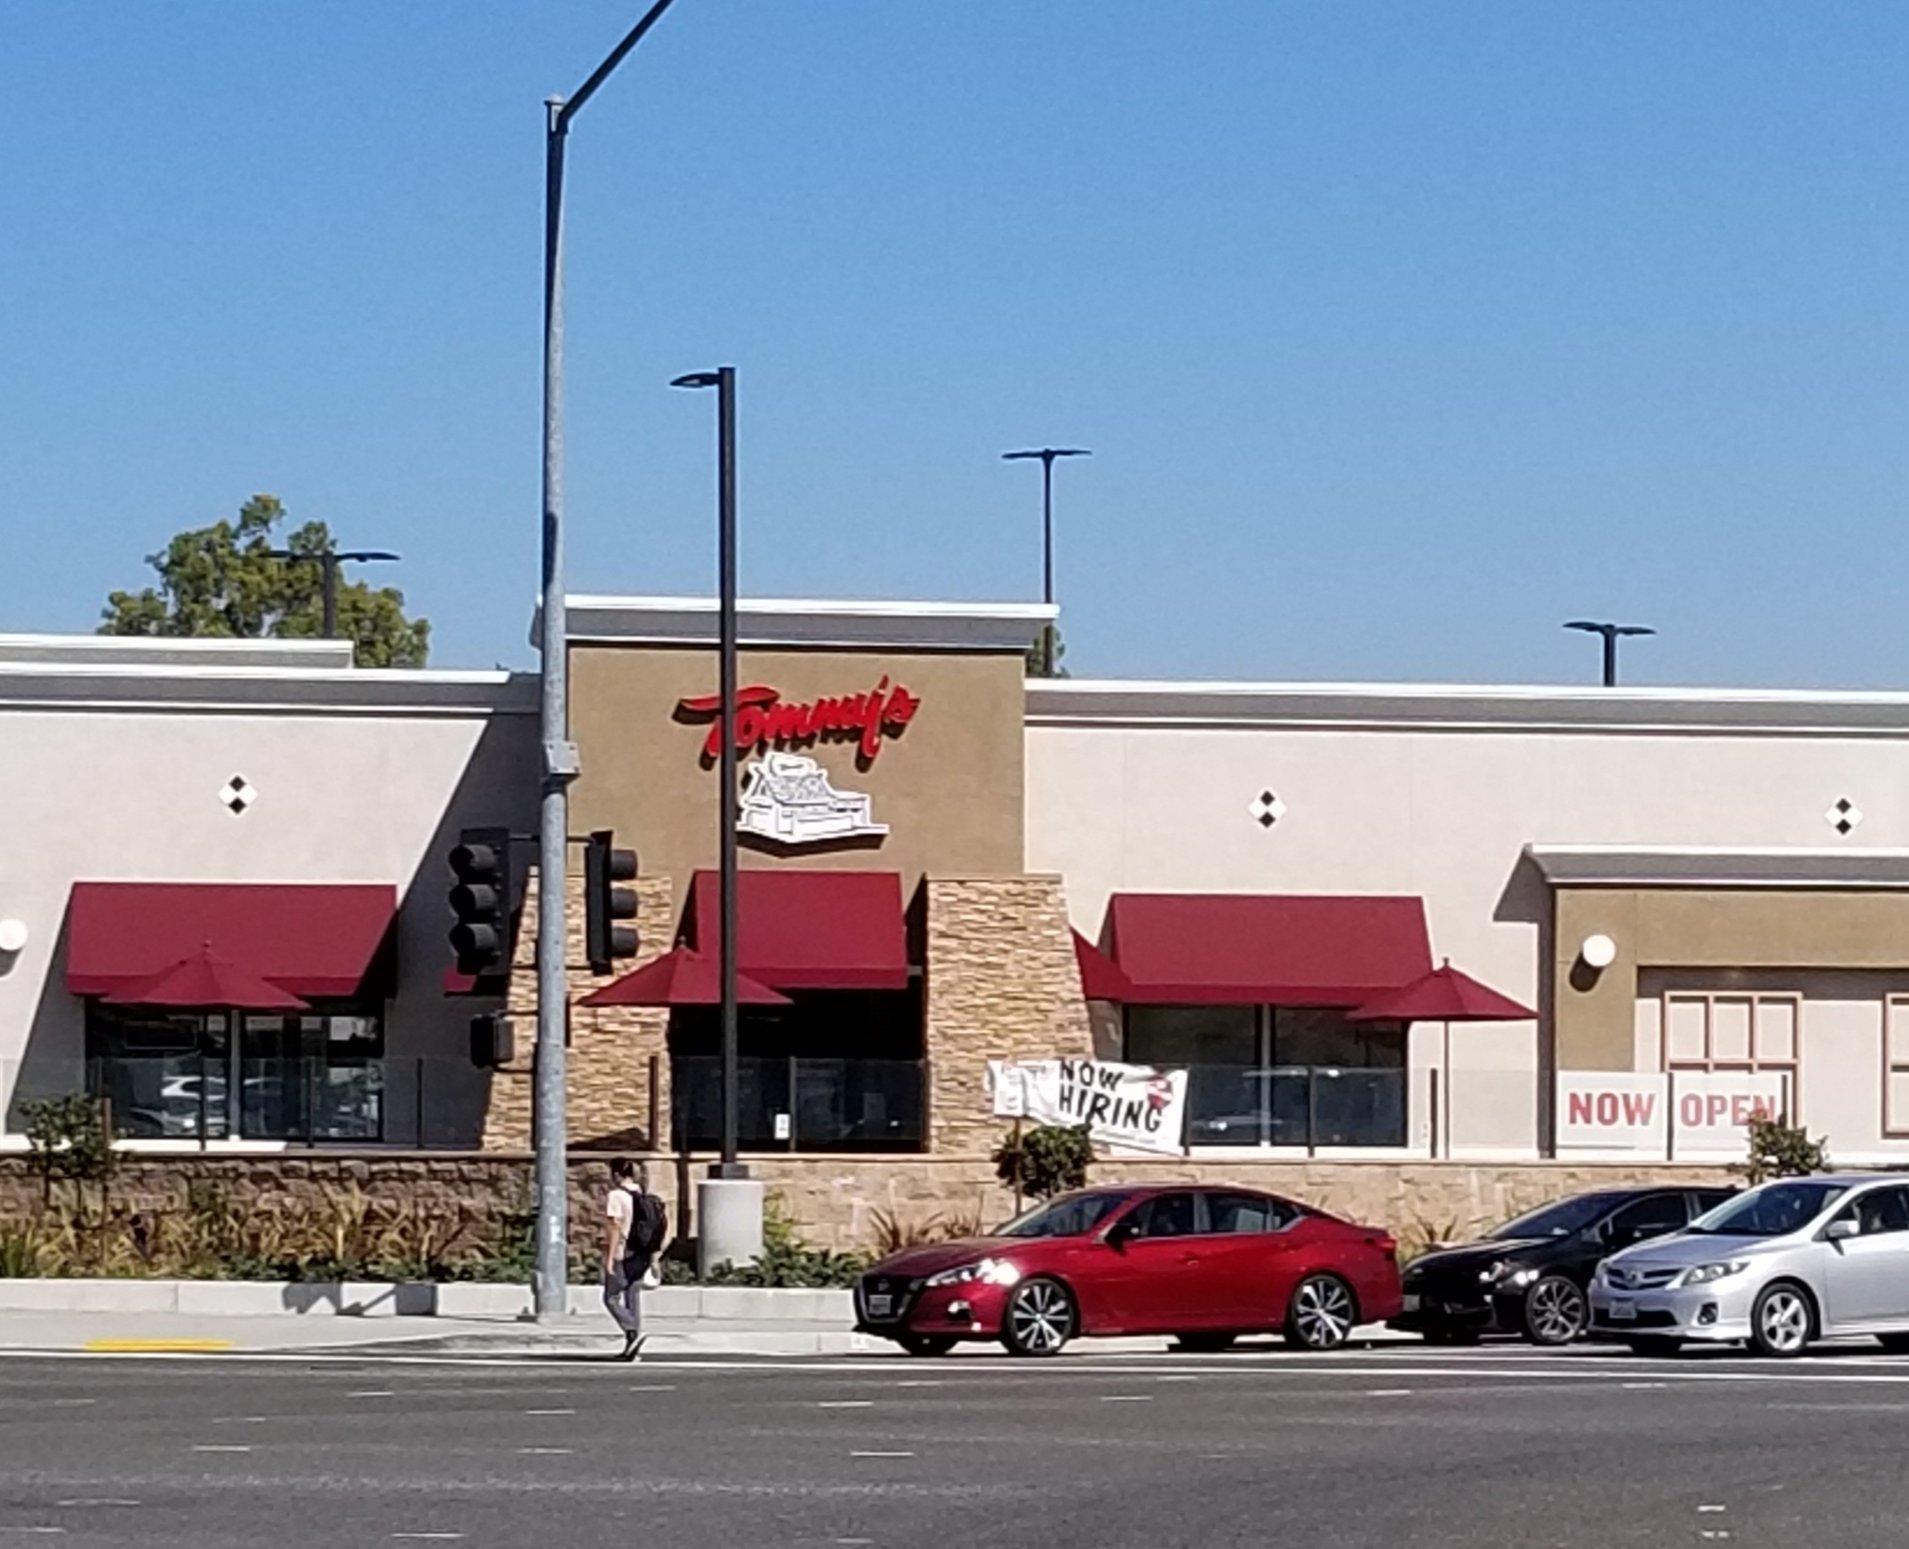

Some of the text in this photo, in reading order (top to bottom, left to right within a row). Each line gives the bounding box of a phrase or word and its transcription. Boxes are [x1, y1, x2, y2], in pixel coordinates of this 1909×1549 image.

[678, 675, 920, 758] Tommy's
[1059, 1057, 1124, 1092] NOW
[1058, 1084, 1163, 1133] HIRING
[1568, 1092, 1776, 1127] NOW OPEN
